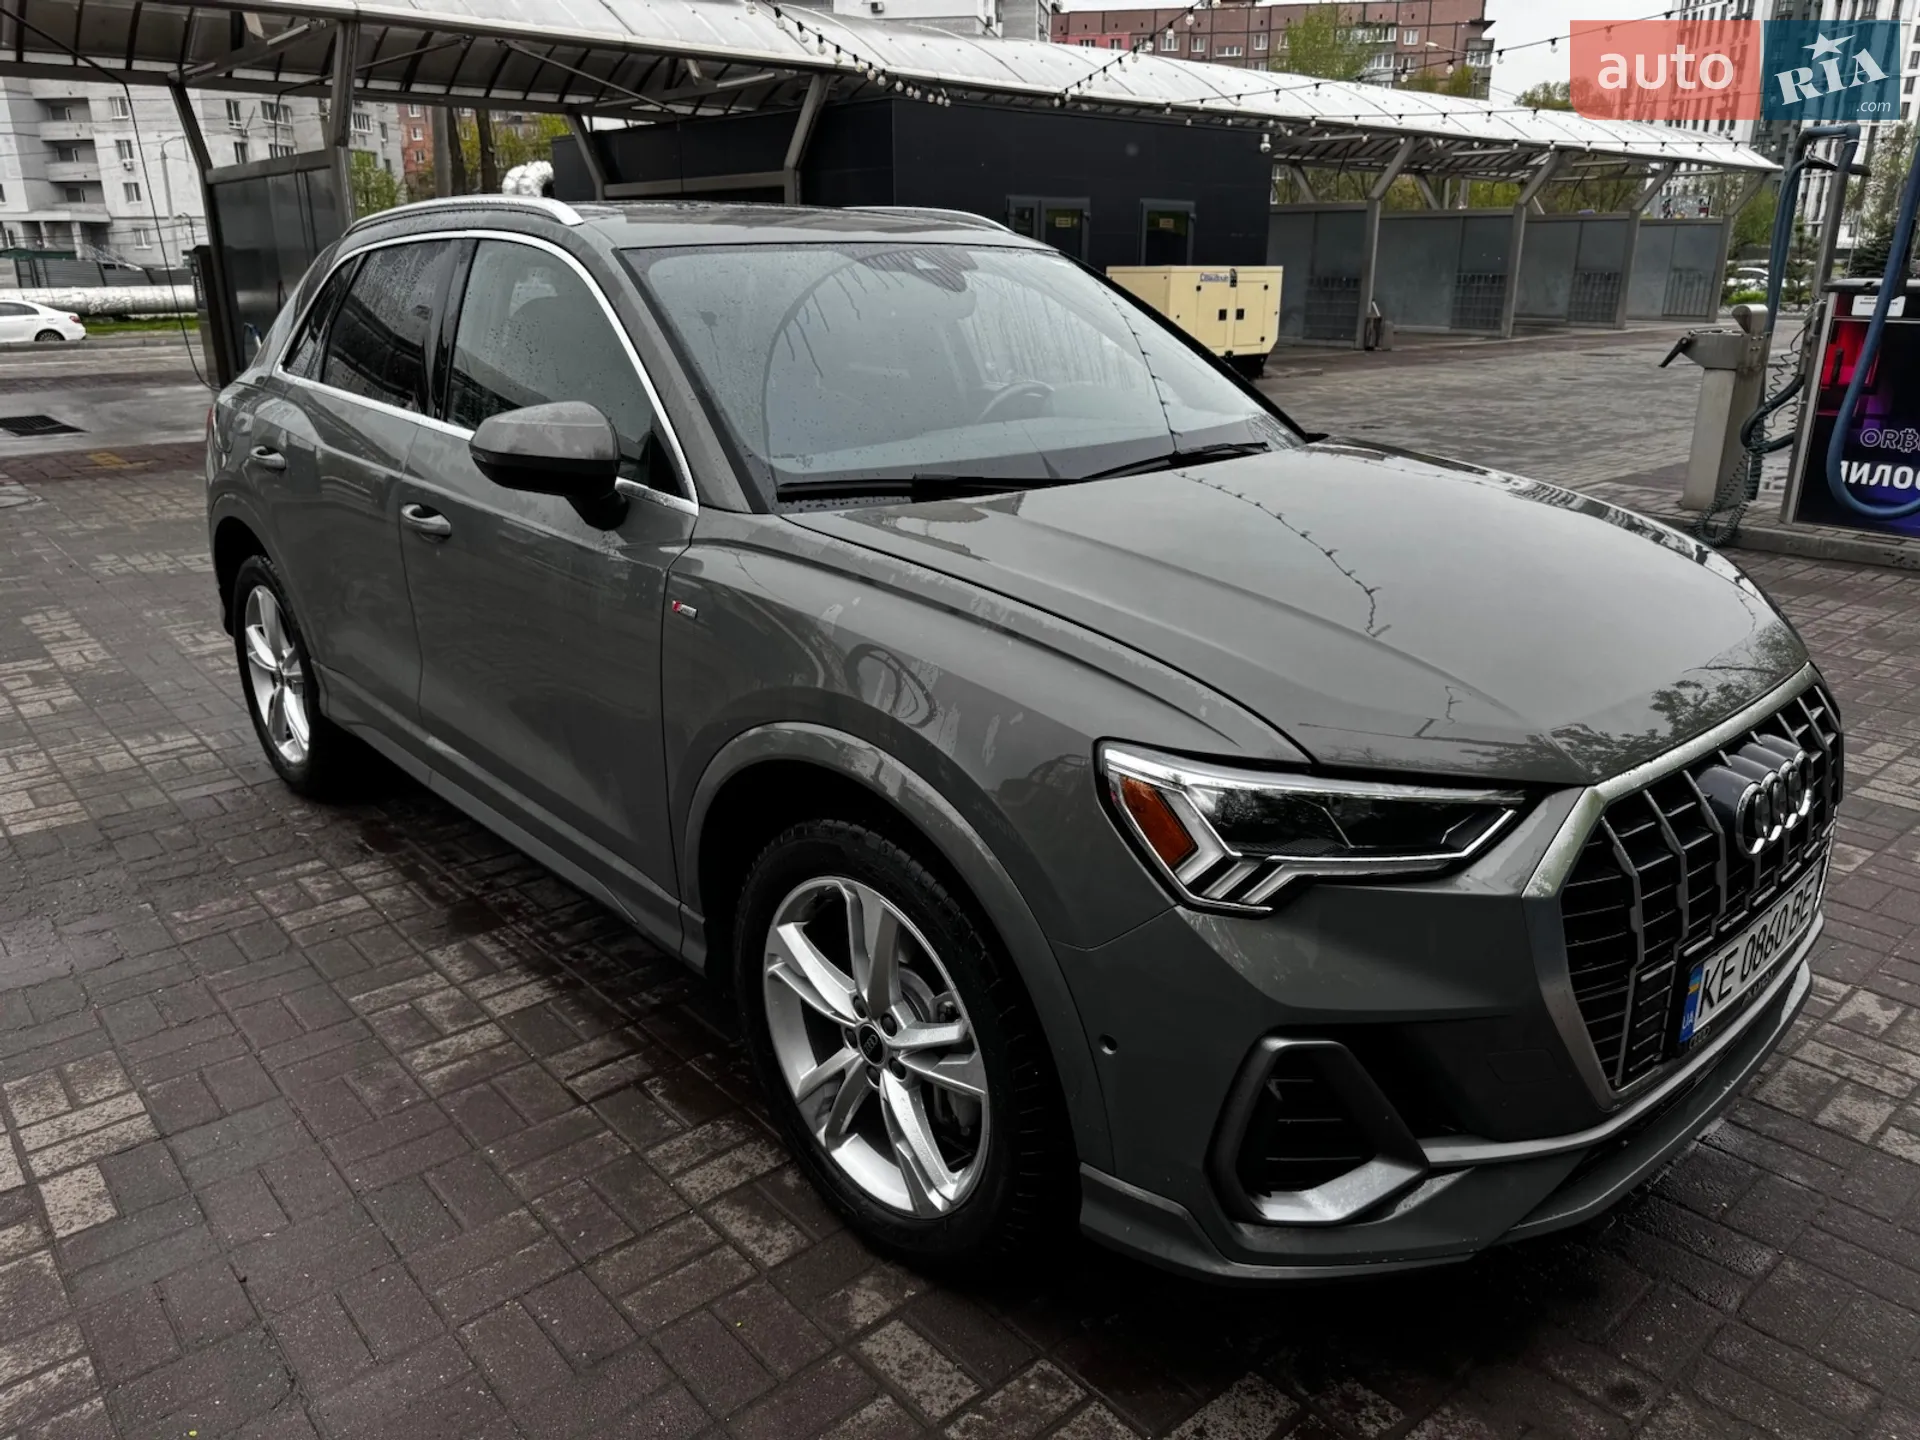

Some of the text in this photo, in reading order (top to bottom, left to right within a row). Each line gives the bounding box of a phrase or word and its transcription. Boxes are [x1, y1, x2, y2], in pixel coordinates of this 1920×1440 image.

[1860, 428, 1920, 453] ORB
[1699, 947, 1739, 1018] KE
[1741, 903, 1789, 982] 0860
[1789, 873, 1815, 938] BE
